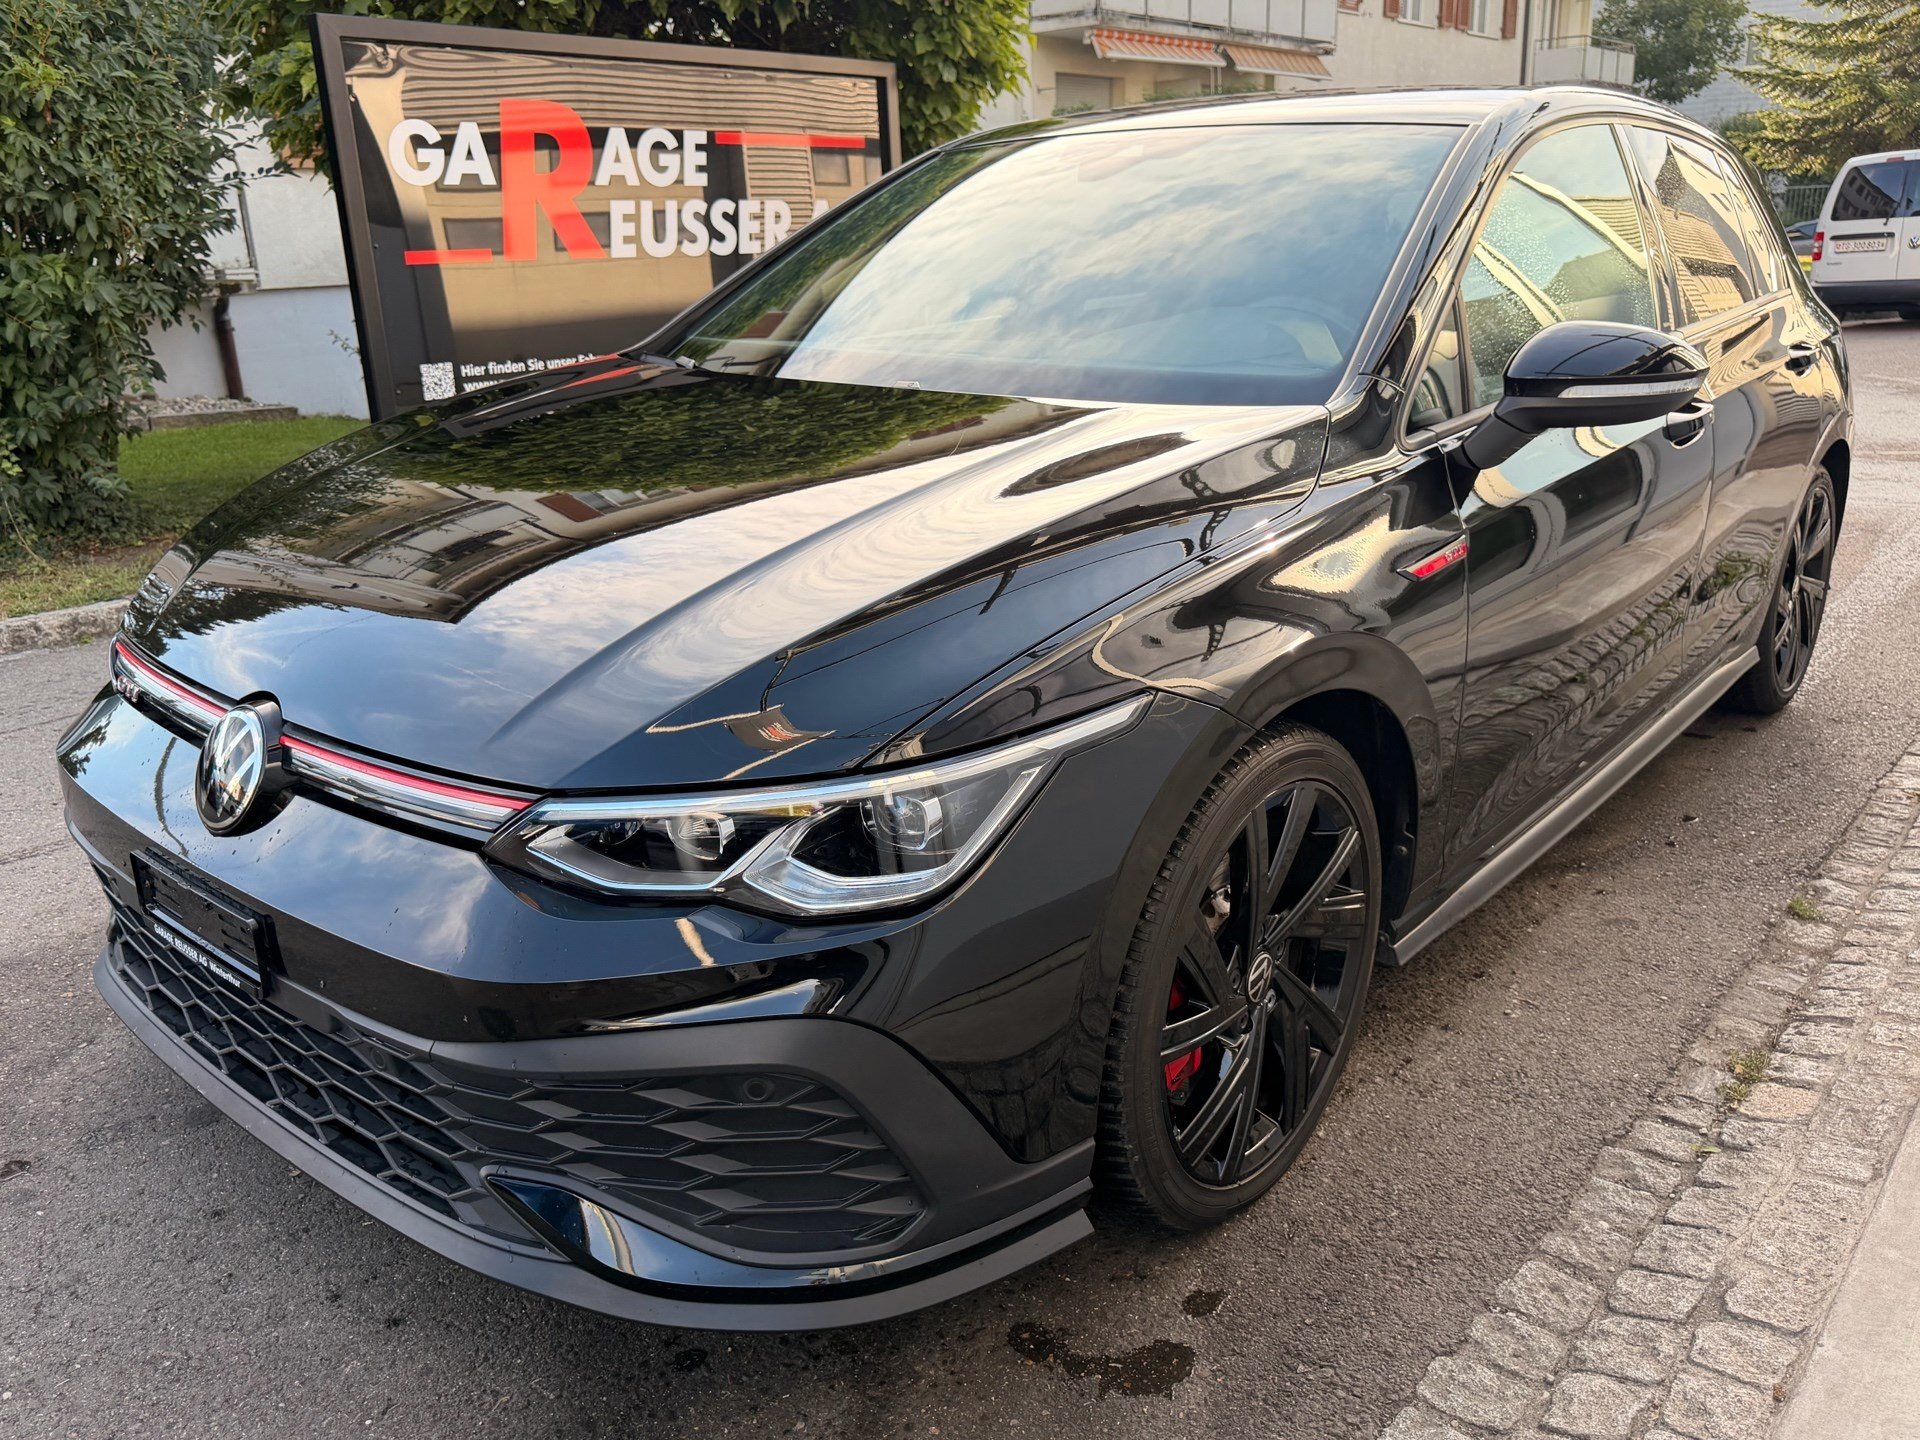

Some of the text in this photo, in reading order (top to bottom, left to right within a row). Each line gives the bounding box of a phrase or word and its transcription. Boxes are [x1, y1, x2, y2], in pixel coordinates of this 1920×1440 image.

[460, 363, 486, 378] Hier
[488, 360, 526, 375] finden
[526, 358, 545, 371] Sie
[117, 675, 141, 703] GTI
[154, 924, 173, 945] GARAGE
[174, 938, 198, 961] REUSSER
